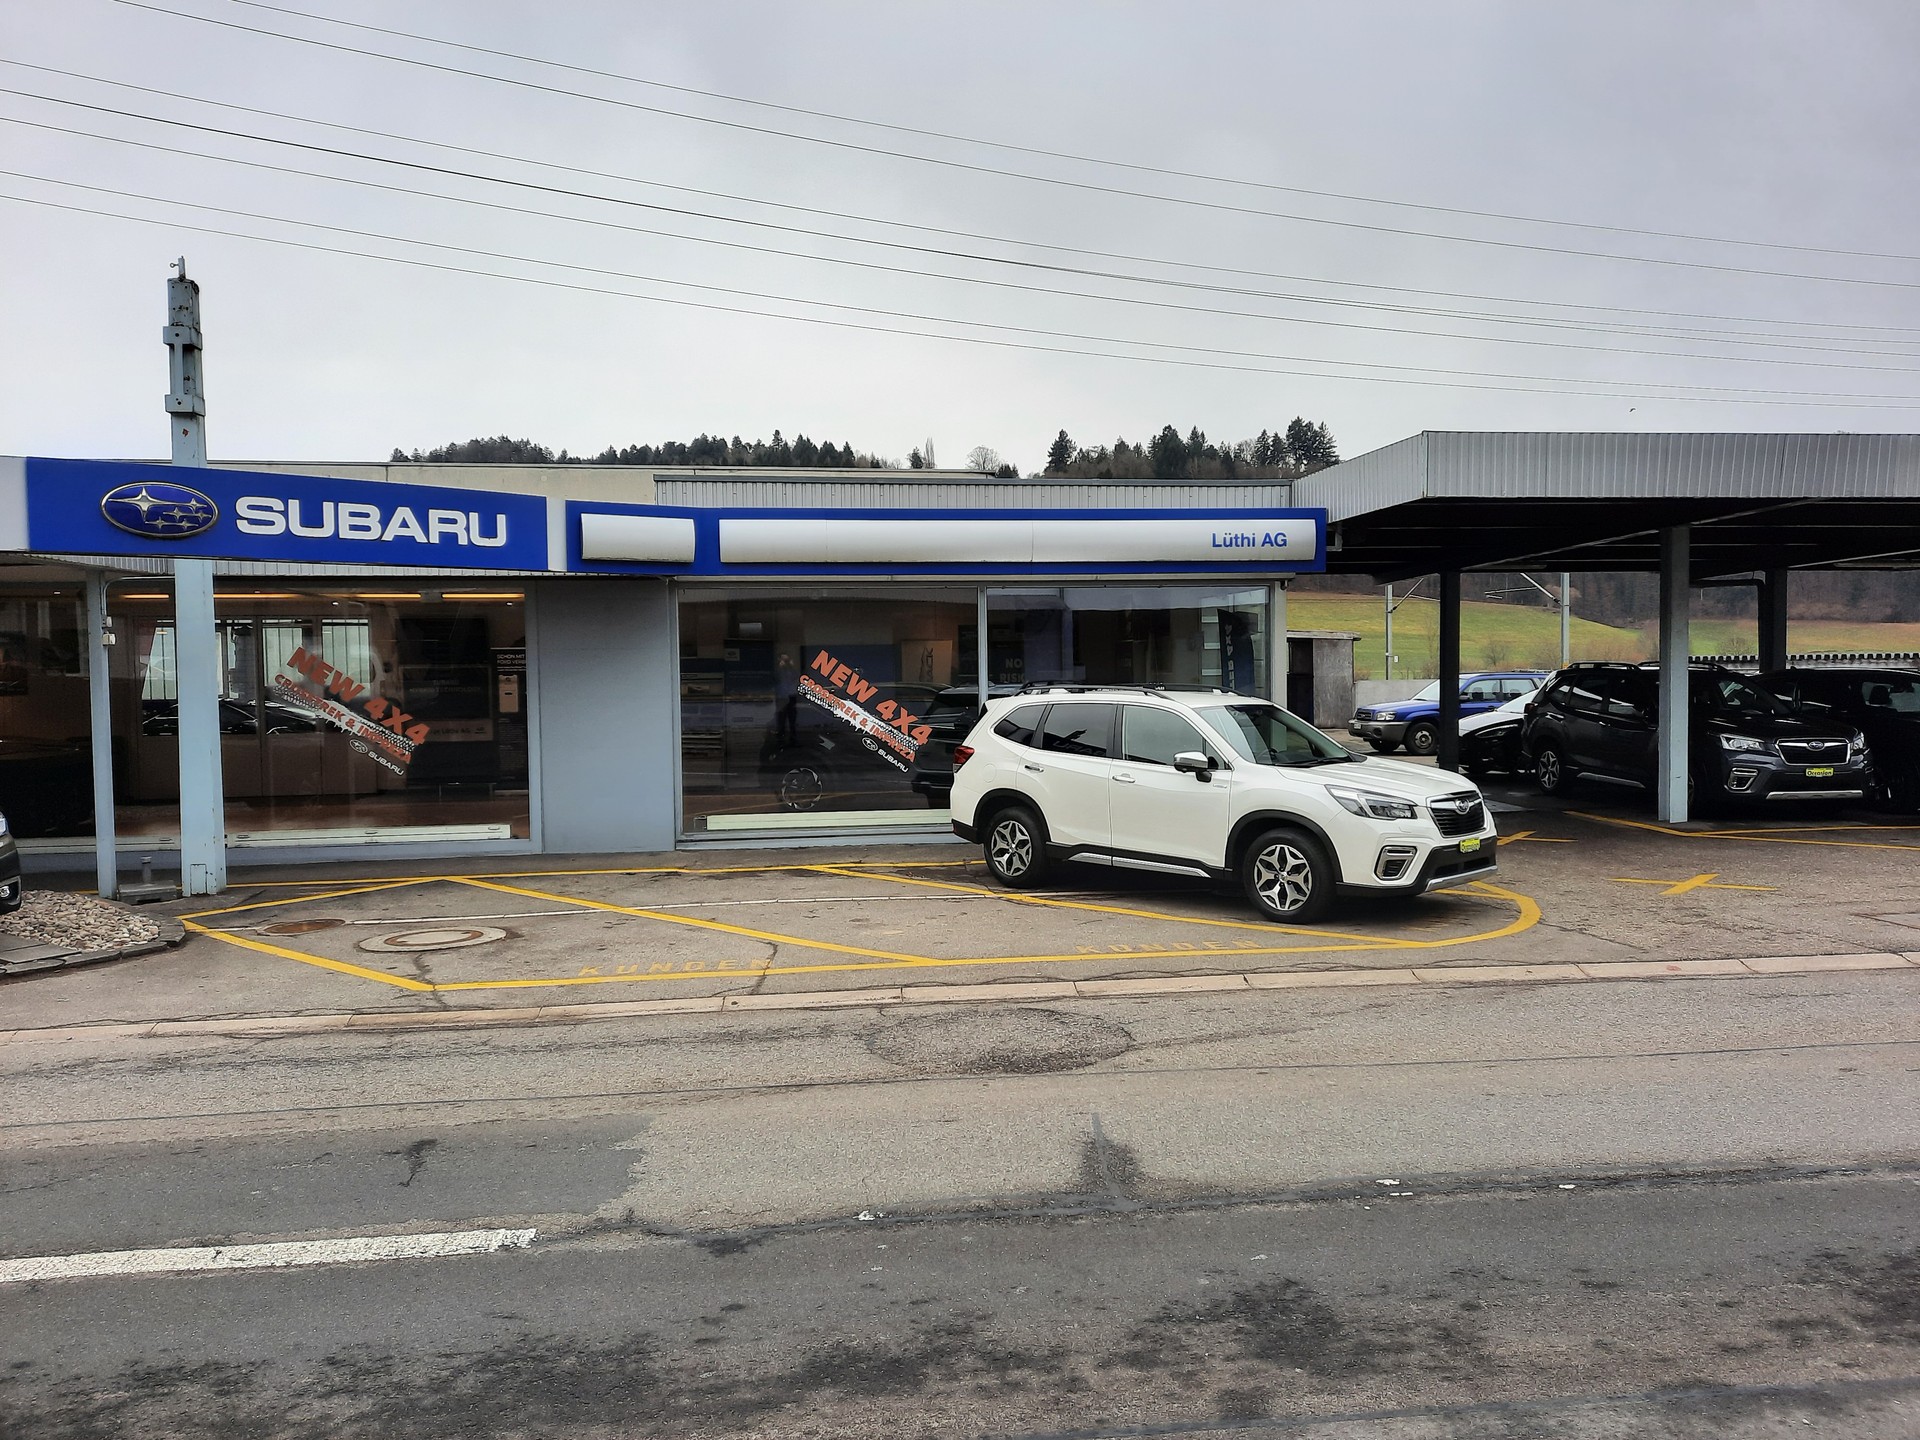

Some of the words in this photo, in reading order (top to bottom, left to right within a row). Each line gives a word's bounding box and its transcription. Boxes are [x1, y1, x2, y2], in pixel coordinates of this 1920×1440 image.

[235, 496, 507, 547] SUBARU
[1212, 532, 1256, 548] Lüthi
[1260, 532, 1288, 548] AG
[1005, 658, 1023, 668] NO
[286, 646, 365, 703] NEW
[363, 696, 431, 746] 4X4
[810, 649, 878, 704] NEW
[875, 699, 933, 746] 4X4
[344, 717, 356, 730] &
[858, 717, 869, 729] &
[869, 724, 917, 763] IMPREZA
[367, 750, 405, 776] SUBARU
[877, 749, 909, 773] SUBARU
[1073, 939, 1262, 954] KUNDEN
[577, 958, 773, 977] KUNDEN
